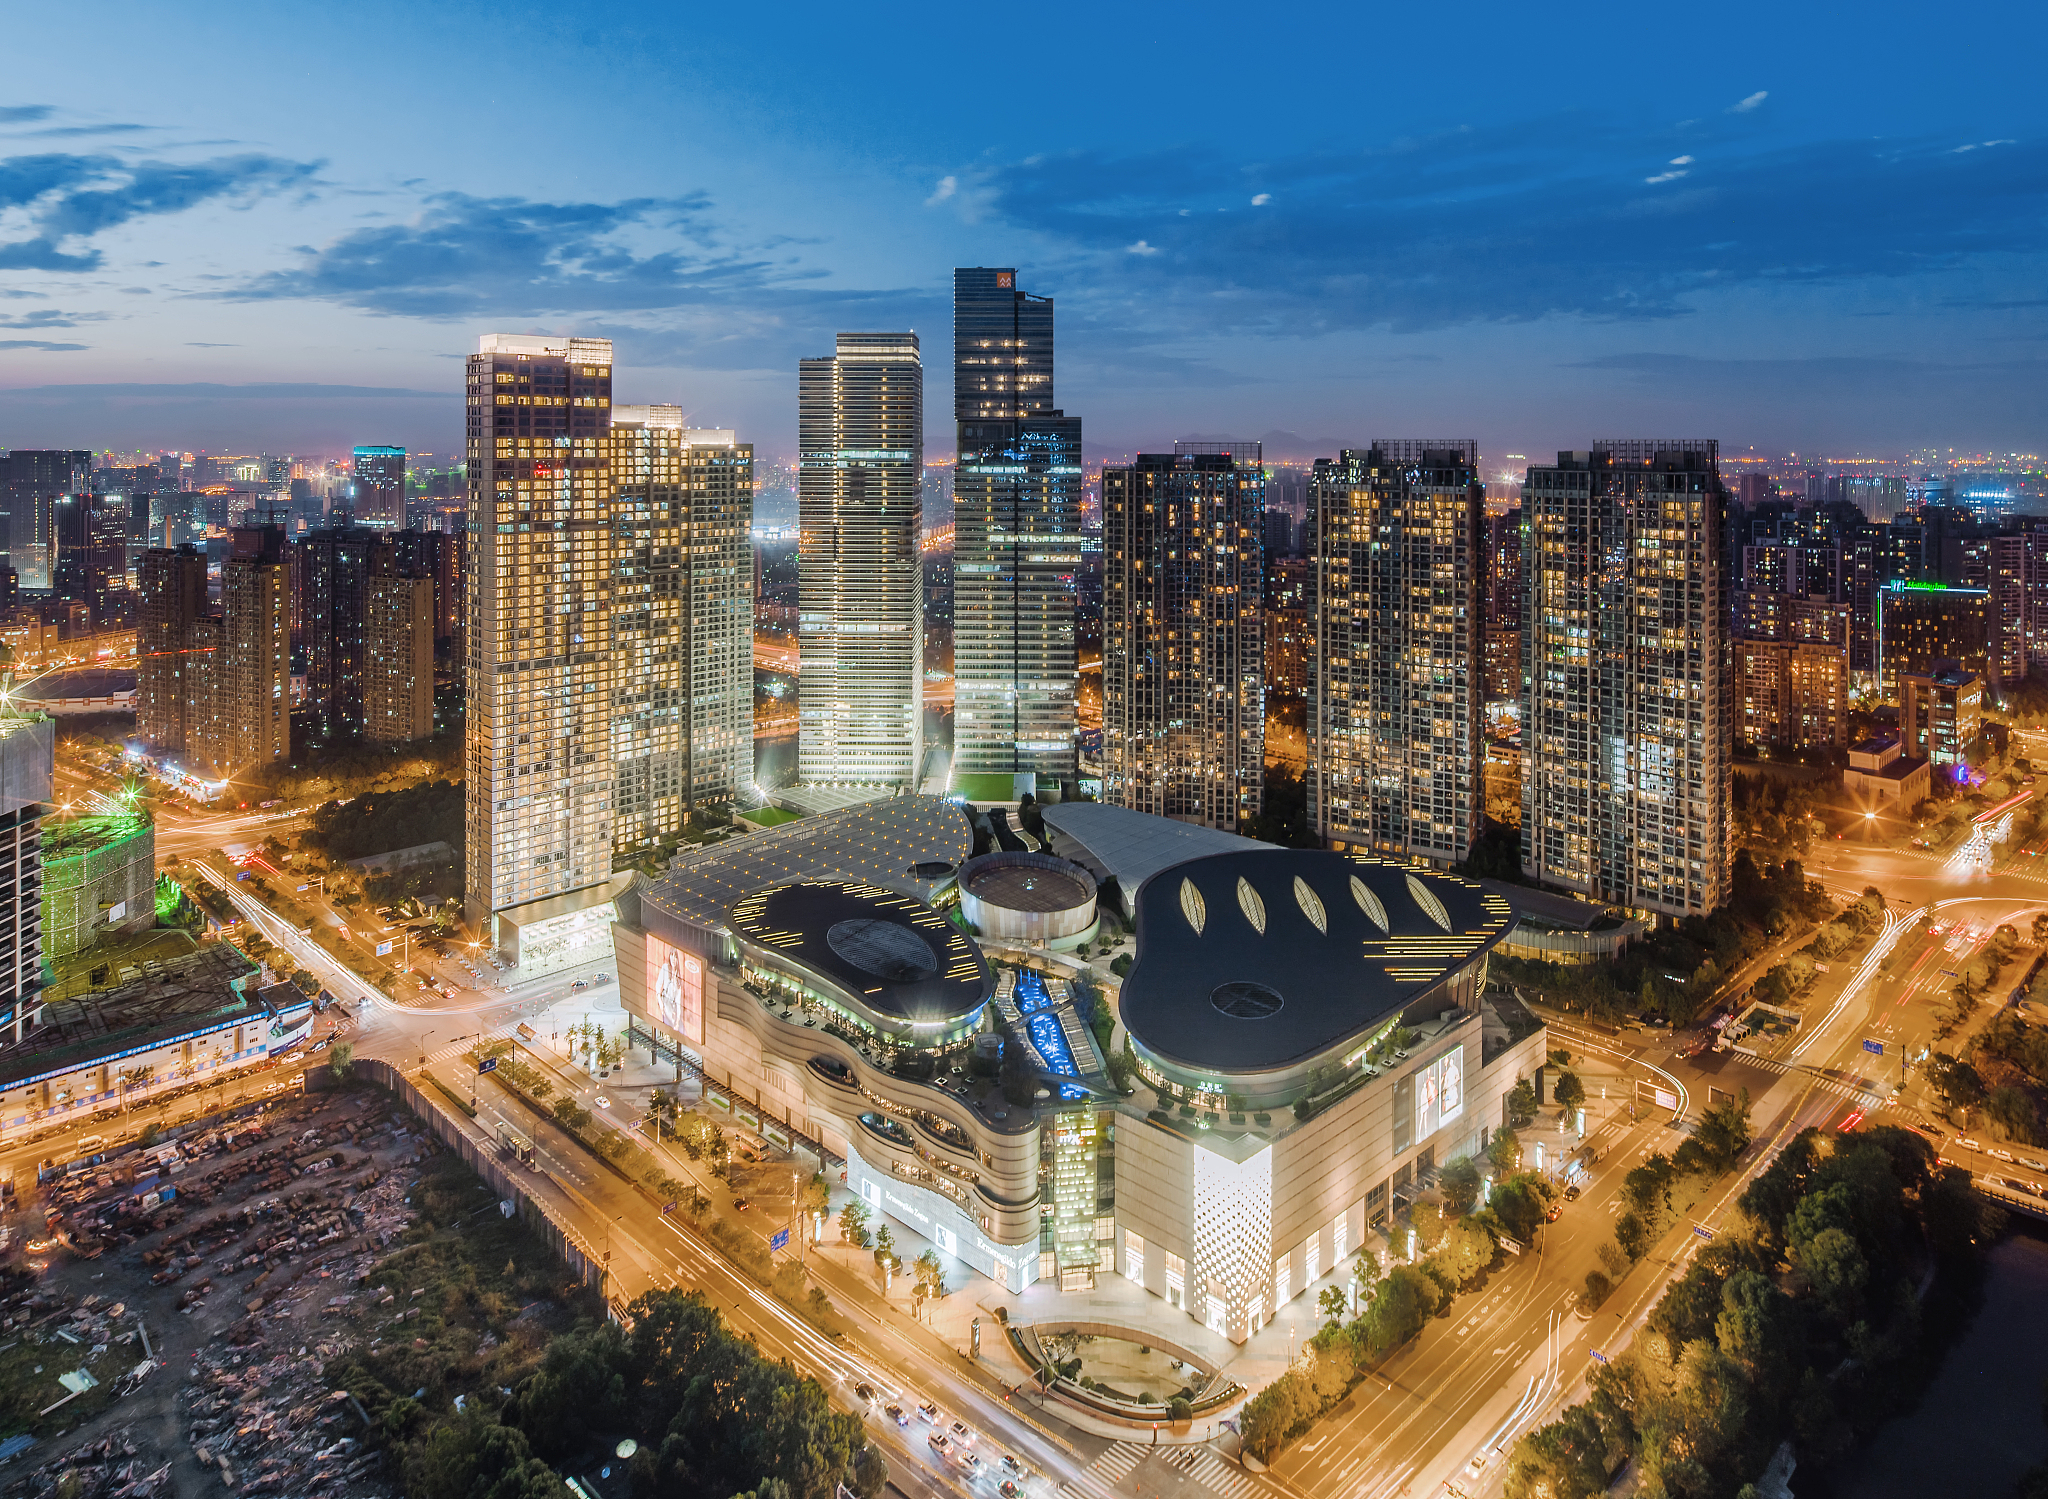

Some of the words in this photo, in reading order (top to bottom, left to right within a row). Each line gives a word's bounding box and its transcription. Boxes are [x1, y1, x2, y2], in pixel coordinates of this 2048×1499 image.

[1907, 581, 1934, 592] Holiday
[1935, 582, 1947, 590] Inn
[977, 1236, 1016, 1269] Ermenegildo
[1018, 1250, 1036, 1269] Zegna
